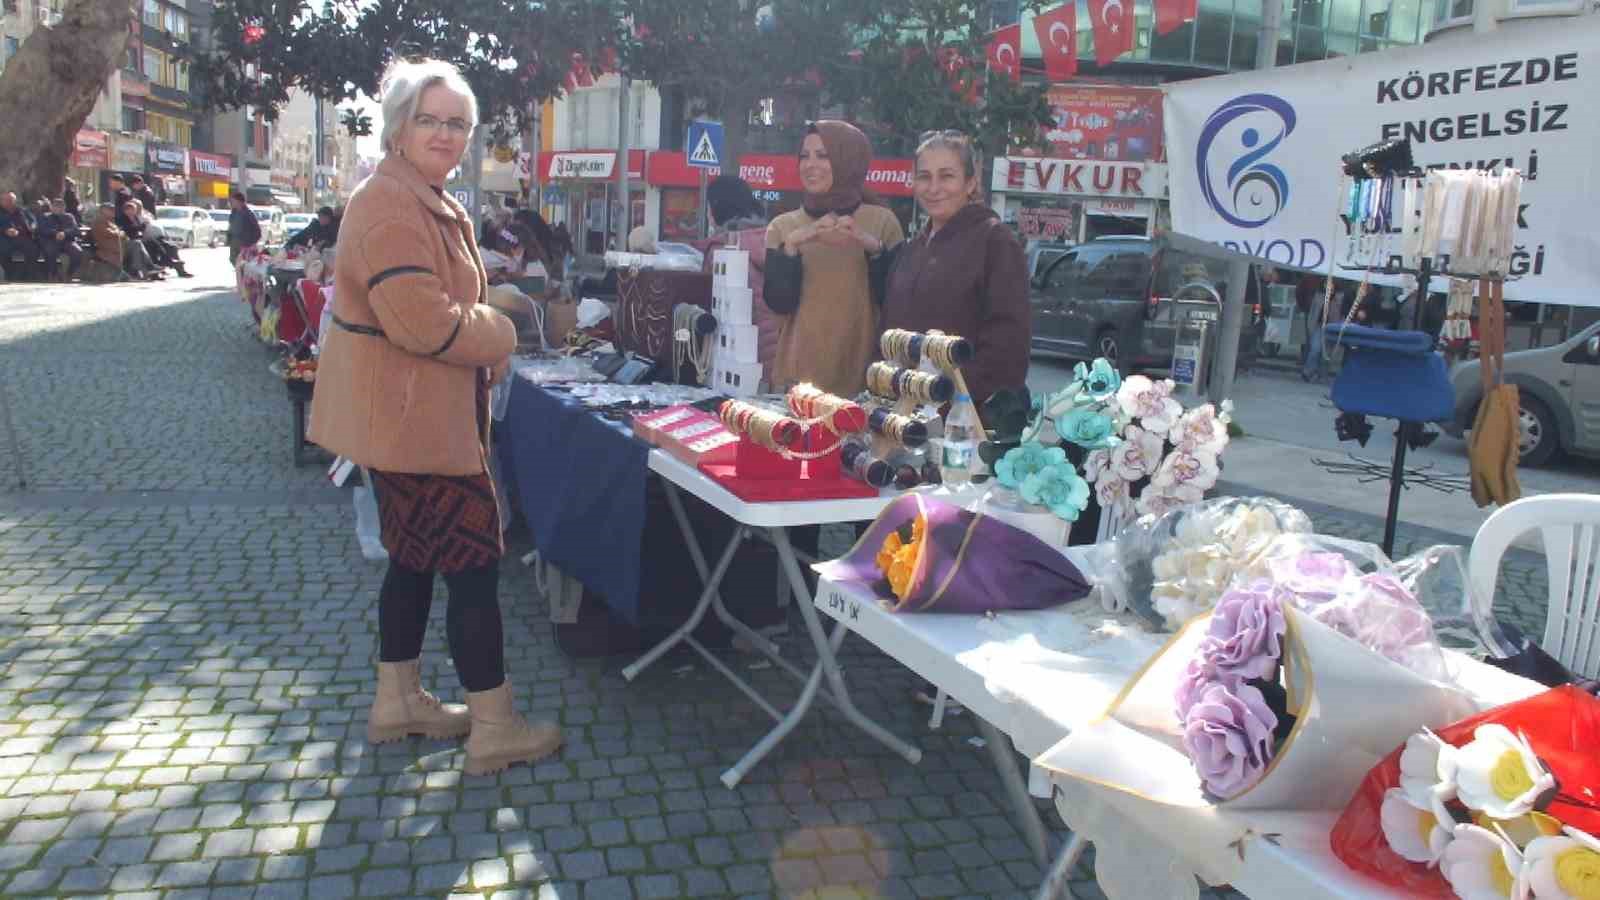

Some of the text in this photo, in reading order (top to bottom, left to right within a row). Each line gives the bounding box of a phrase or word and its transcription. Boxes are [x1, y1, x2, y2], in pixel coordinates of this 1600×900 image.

[1376, 52, 1578, 104] KÖRFEZDE
[1382, 100, 1568, 144] ENGELSİZ
[1007, 161, 1142, 193] EVKUR
